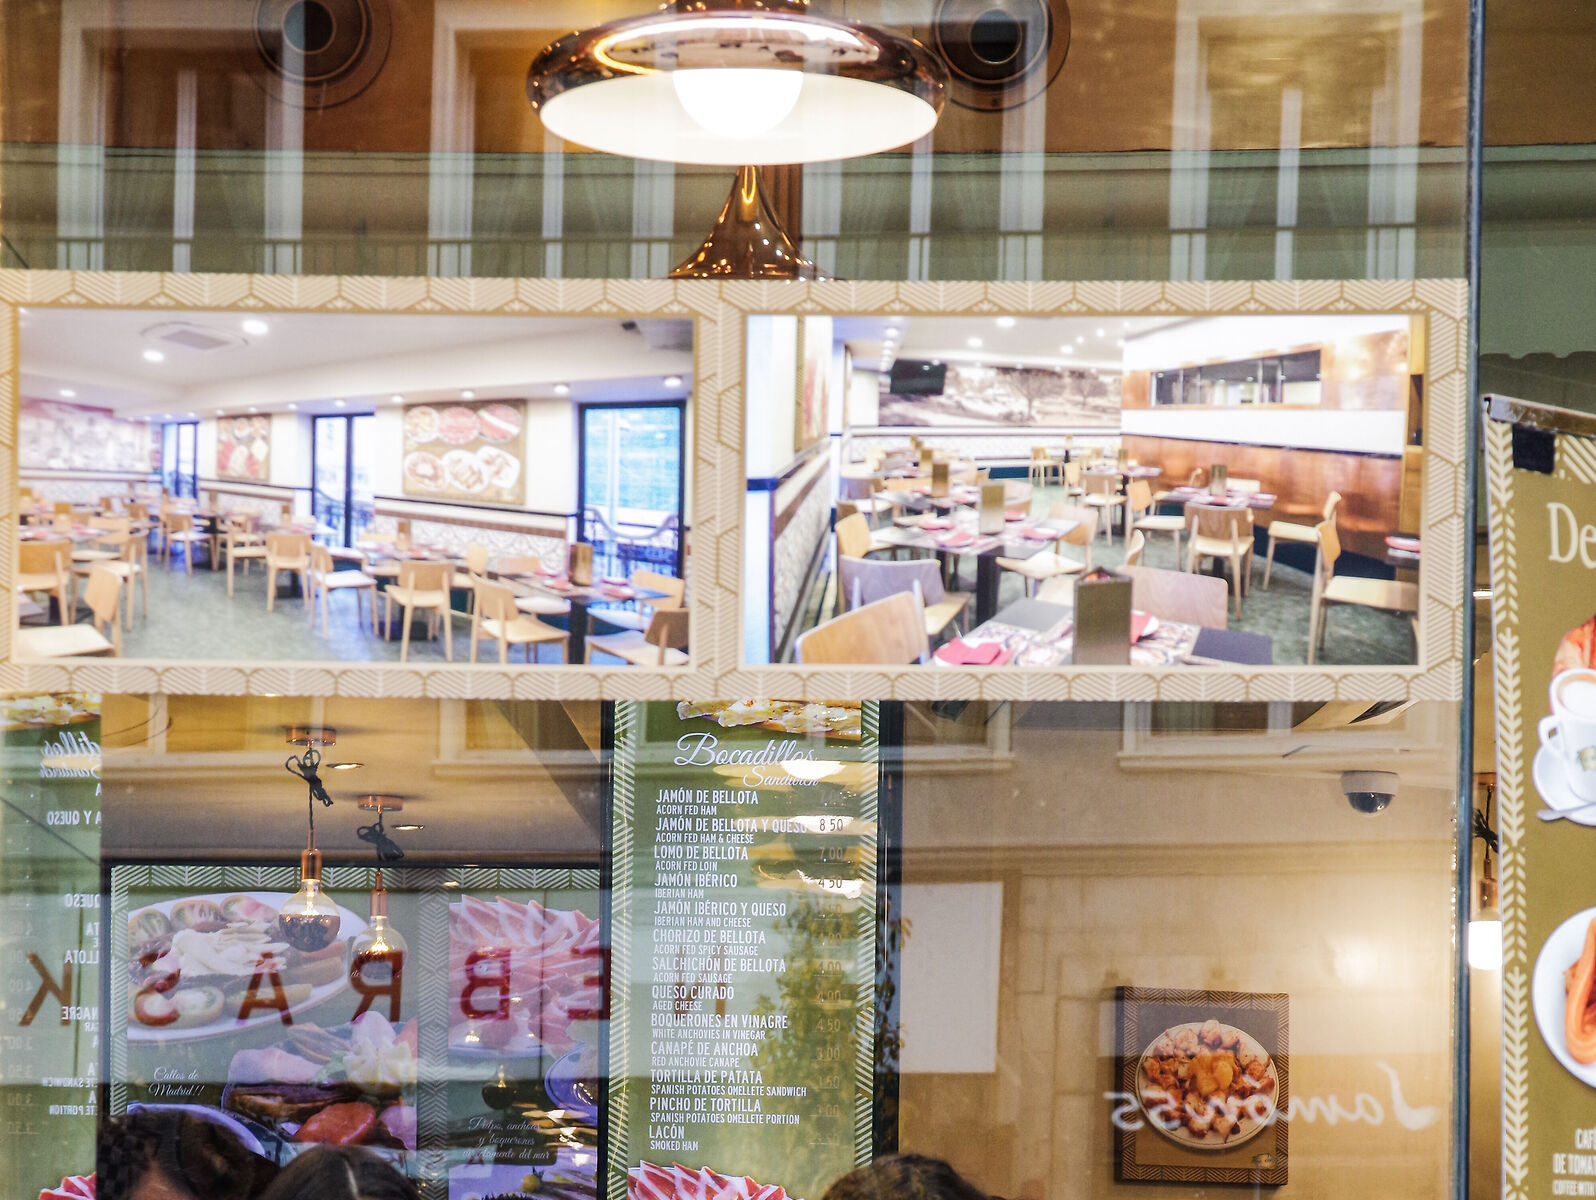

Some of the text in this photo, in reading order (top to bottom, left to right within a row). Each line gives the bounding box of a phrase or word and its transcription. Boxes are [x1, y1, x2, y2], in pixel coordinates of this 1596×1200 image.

[1546, 502, 1596, 569] De
[673, 732, 818, 766] Bocadillos
[656, 787, 759, 805] JAMÓN DE BELLOTA
[656, 805, 717, 815] ACORN FED HAM
[656, 816, 694, 832] JAMÓN
[695, 818, 709, 832] DE
[711, 819, 758, 833] BELLOTA
[760, 819, 769, 833] Y
[656, 833, 754, 844] ACORN FED HAM & CHEESE
[654, 845, 683, 859] LOMO
[686, 846, 699, 859] DE
[702, 846, 748, 860] BELLOTA
[656, 861, 718, 871] ACORN FED LOIN
[654, 871, 692, 887] JAMÓN
[694, 871, 737, 888] IBÉRICO
[655, 888, 704, 898] IBERIAN HAM
[654, 899, 786, 917] JAMÓN IBÉRICO Y QUESO
[655, 916, 751, 928] IBERIAN HAM AND CHEESE
[653, 929, 766, 944] CHORIZO DE BELLOTA
[654, 944, 759, 956] ACORN FED SPICY SAUSAGE
[652, 955, 721, 971] SALCHICHÓN
[724, 958, 737, 971] DE
[740, 958, 786, 972] BELLOTA
[653, 972, 733, 984] ACORN FED SAUSAGE
[652, 985, 687, 1000] QUESO
[690, 986, 734, 1000] CURADO
[653, 1001, 703, 1011] AGED CHEESE
[651, 1013, 722, 1028] BOQUERONES
[724, 1015, 738, 1028] EN
[741, 1015, 788, 1029] VINAGRE
[652, 1029, 766, 1040] WHITE ANCHOVIES IN VINEGAR
[651, 1039, 693, 1055] CANAPÉ
[697, 1042, 710, 1055] DE
[713, 1042, 759, 1056] ANCHOA
[651, 1057, 739, 1068] RED ANCHOVIE CANAPE
[650, 1069, 762, 1084] TORTILLA DE PATATA
[651, 1084, 807, 1097] SPANISH POTATOES OMELLETE SANDWICH
[650, 1097, 761, 1112] PINCHO DE TORTILLA
[651, 1113, 800, 1124] SPANISH POTATOES OMELLETE PORTION
[650, 1124, 685, 1139] LACÓN
[650, 1140, 699, 1151] SMOKED HAM
[1552, 1153, 1566, 1174] DE
